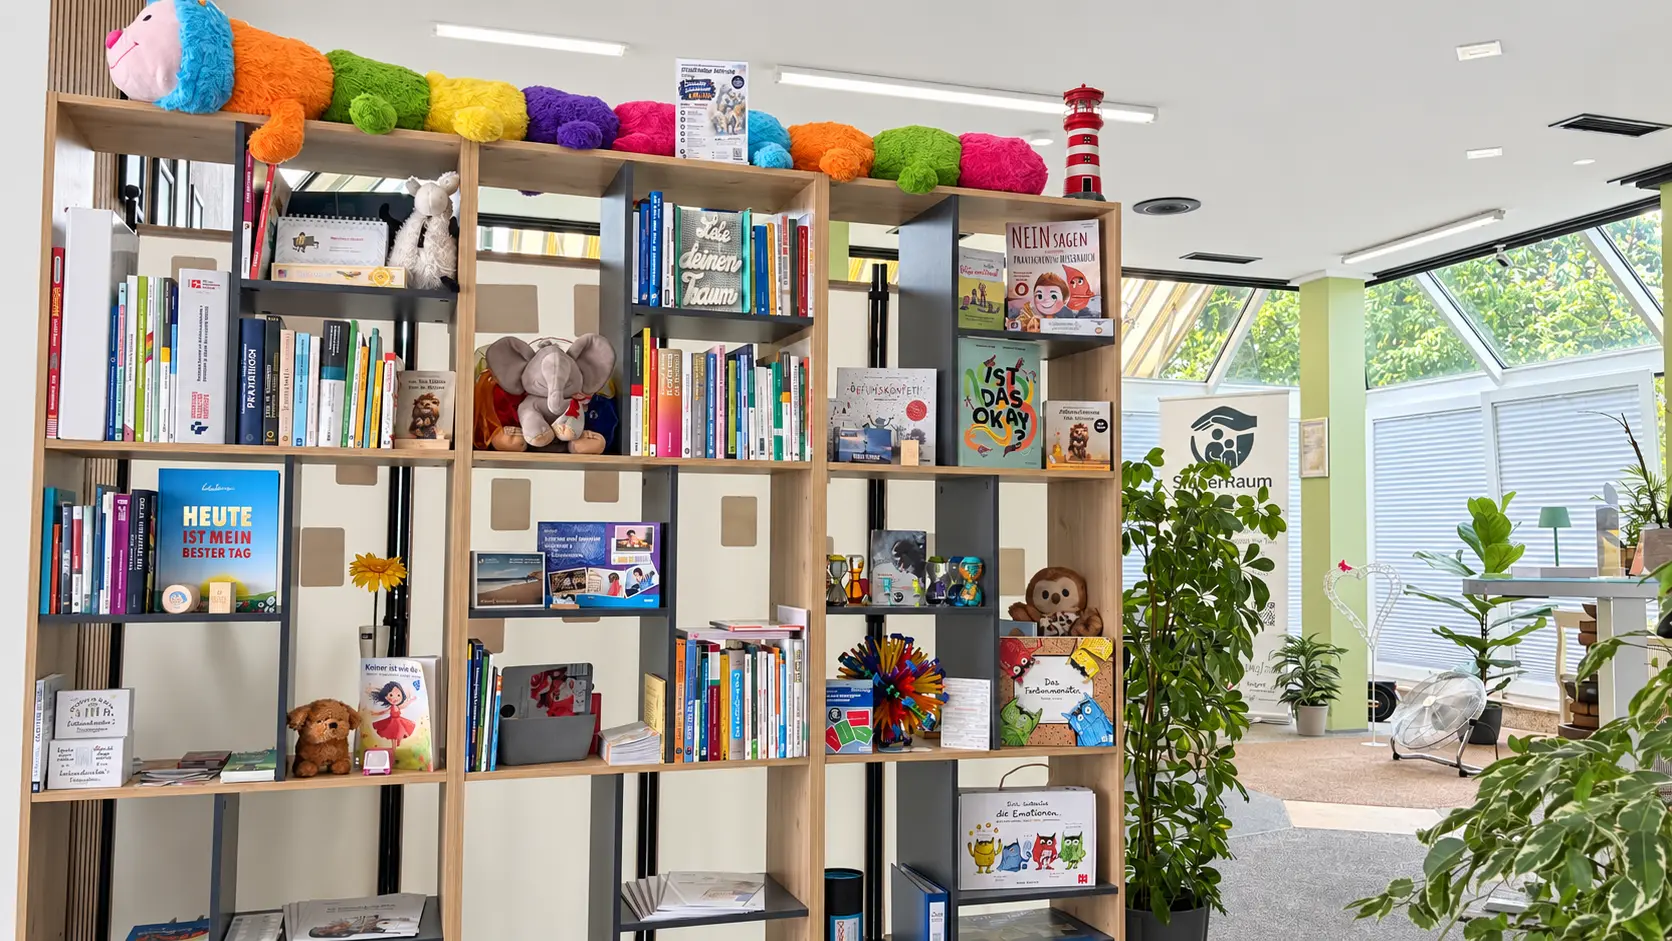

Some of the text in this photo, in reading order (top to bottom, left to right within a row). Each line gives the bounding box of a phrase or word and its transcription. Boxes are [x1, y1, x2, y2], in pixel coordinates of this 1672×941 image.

[696, 213, 731, 243] Lebe
[1012, 226, 1088, 250] NEIN SAGEN
[679, 242, 742, 273] deinen
[682, 272, 738, 306] Traum
[985, 366, 1019, 387] IST
[981, 386, 1024, 409] DAS
[972, 407, 1030, 430] OKAY
[183, 505, 253, 527] HEUTE
[183, 530, 252, 545] IST MEIN
[182, 547, 252, 559] BESTER TAG
[389, 664, 398, 672] ist
